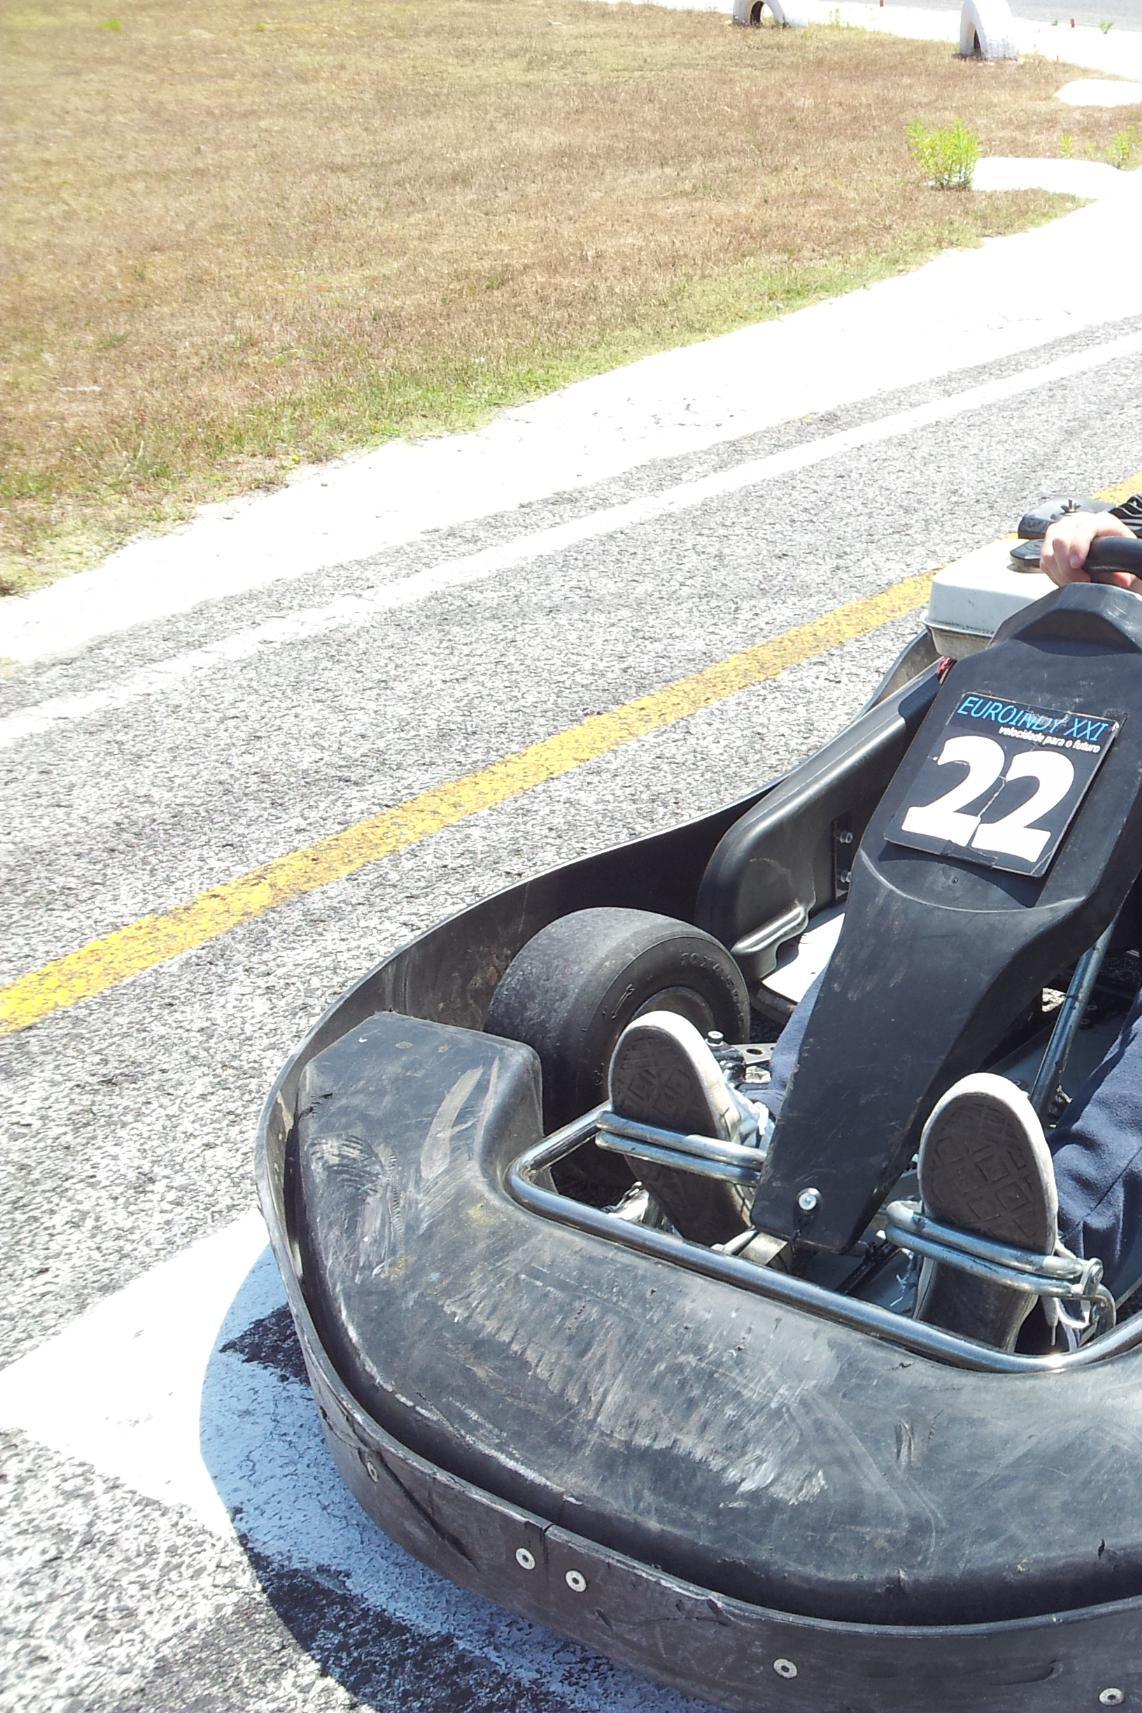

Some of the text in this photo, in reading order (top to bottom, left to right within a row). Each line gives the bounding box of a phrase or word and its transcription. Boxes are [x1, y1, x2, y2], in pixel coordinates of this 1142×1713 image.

[957, 696, 1109, 741] EUROINDY XXI
[998, 726, 1101, 753] velocidade para o futuro
[901, 735, 1075, 862] 22
